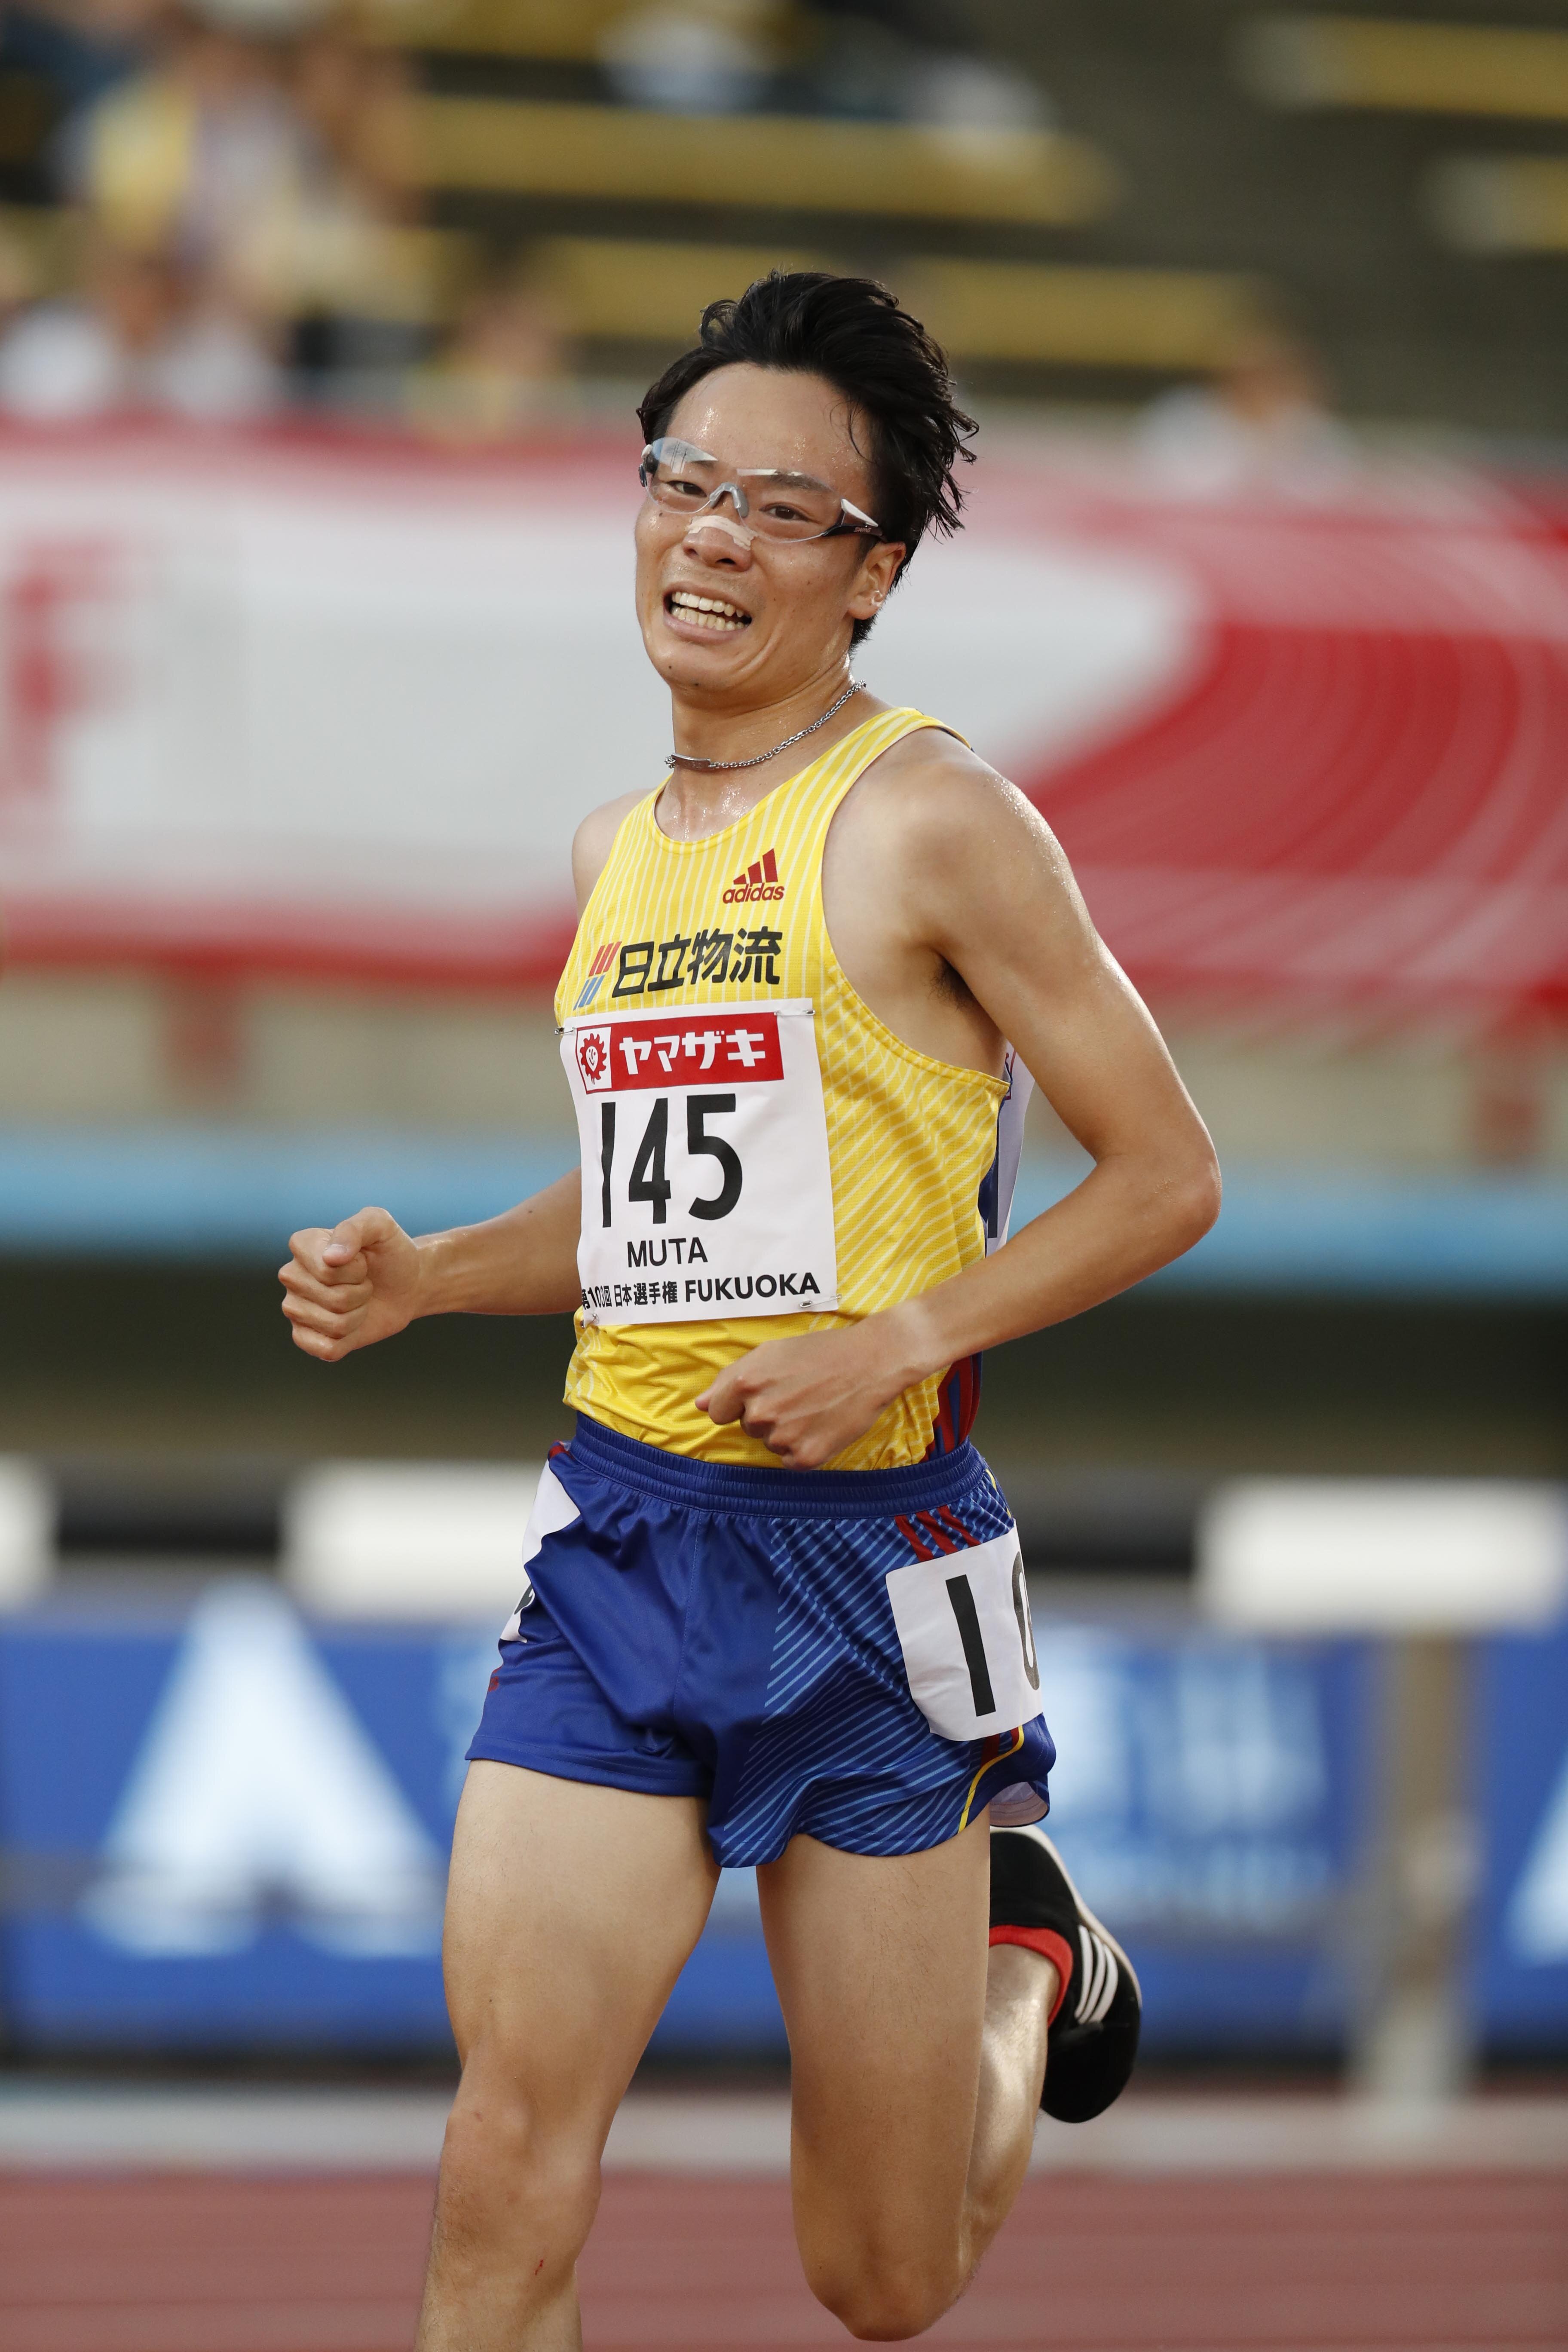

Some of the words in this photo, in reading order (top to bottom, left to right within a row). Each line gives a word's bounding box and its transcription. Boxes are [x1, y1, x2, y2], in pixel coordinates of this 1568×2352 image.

[723, 882, 785, 904] adidas
[612, 926, 783, 998] 日立物流
[619, 1029, 766, 1075] ヤマザキ
[601, 1093, 743, 1228] 145
[627, 1237, 708, 1268] MUTA
[614, 1280, 678, 1308] 日本選手権
[685, 1272, 821, 1303] FUKUOKA
